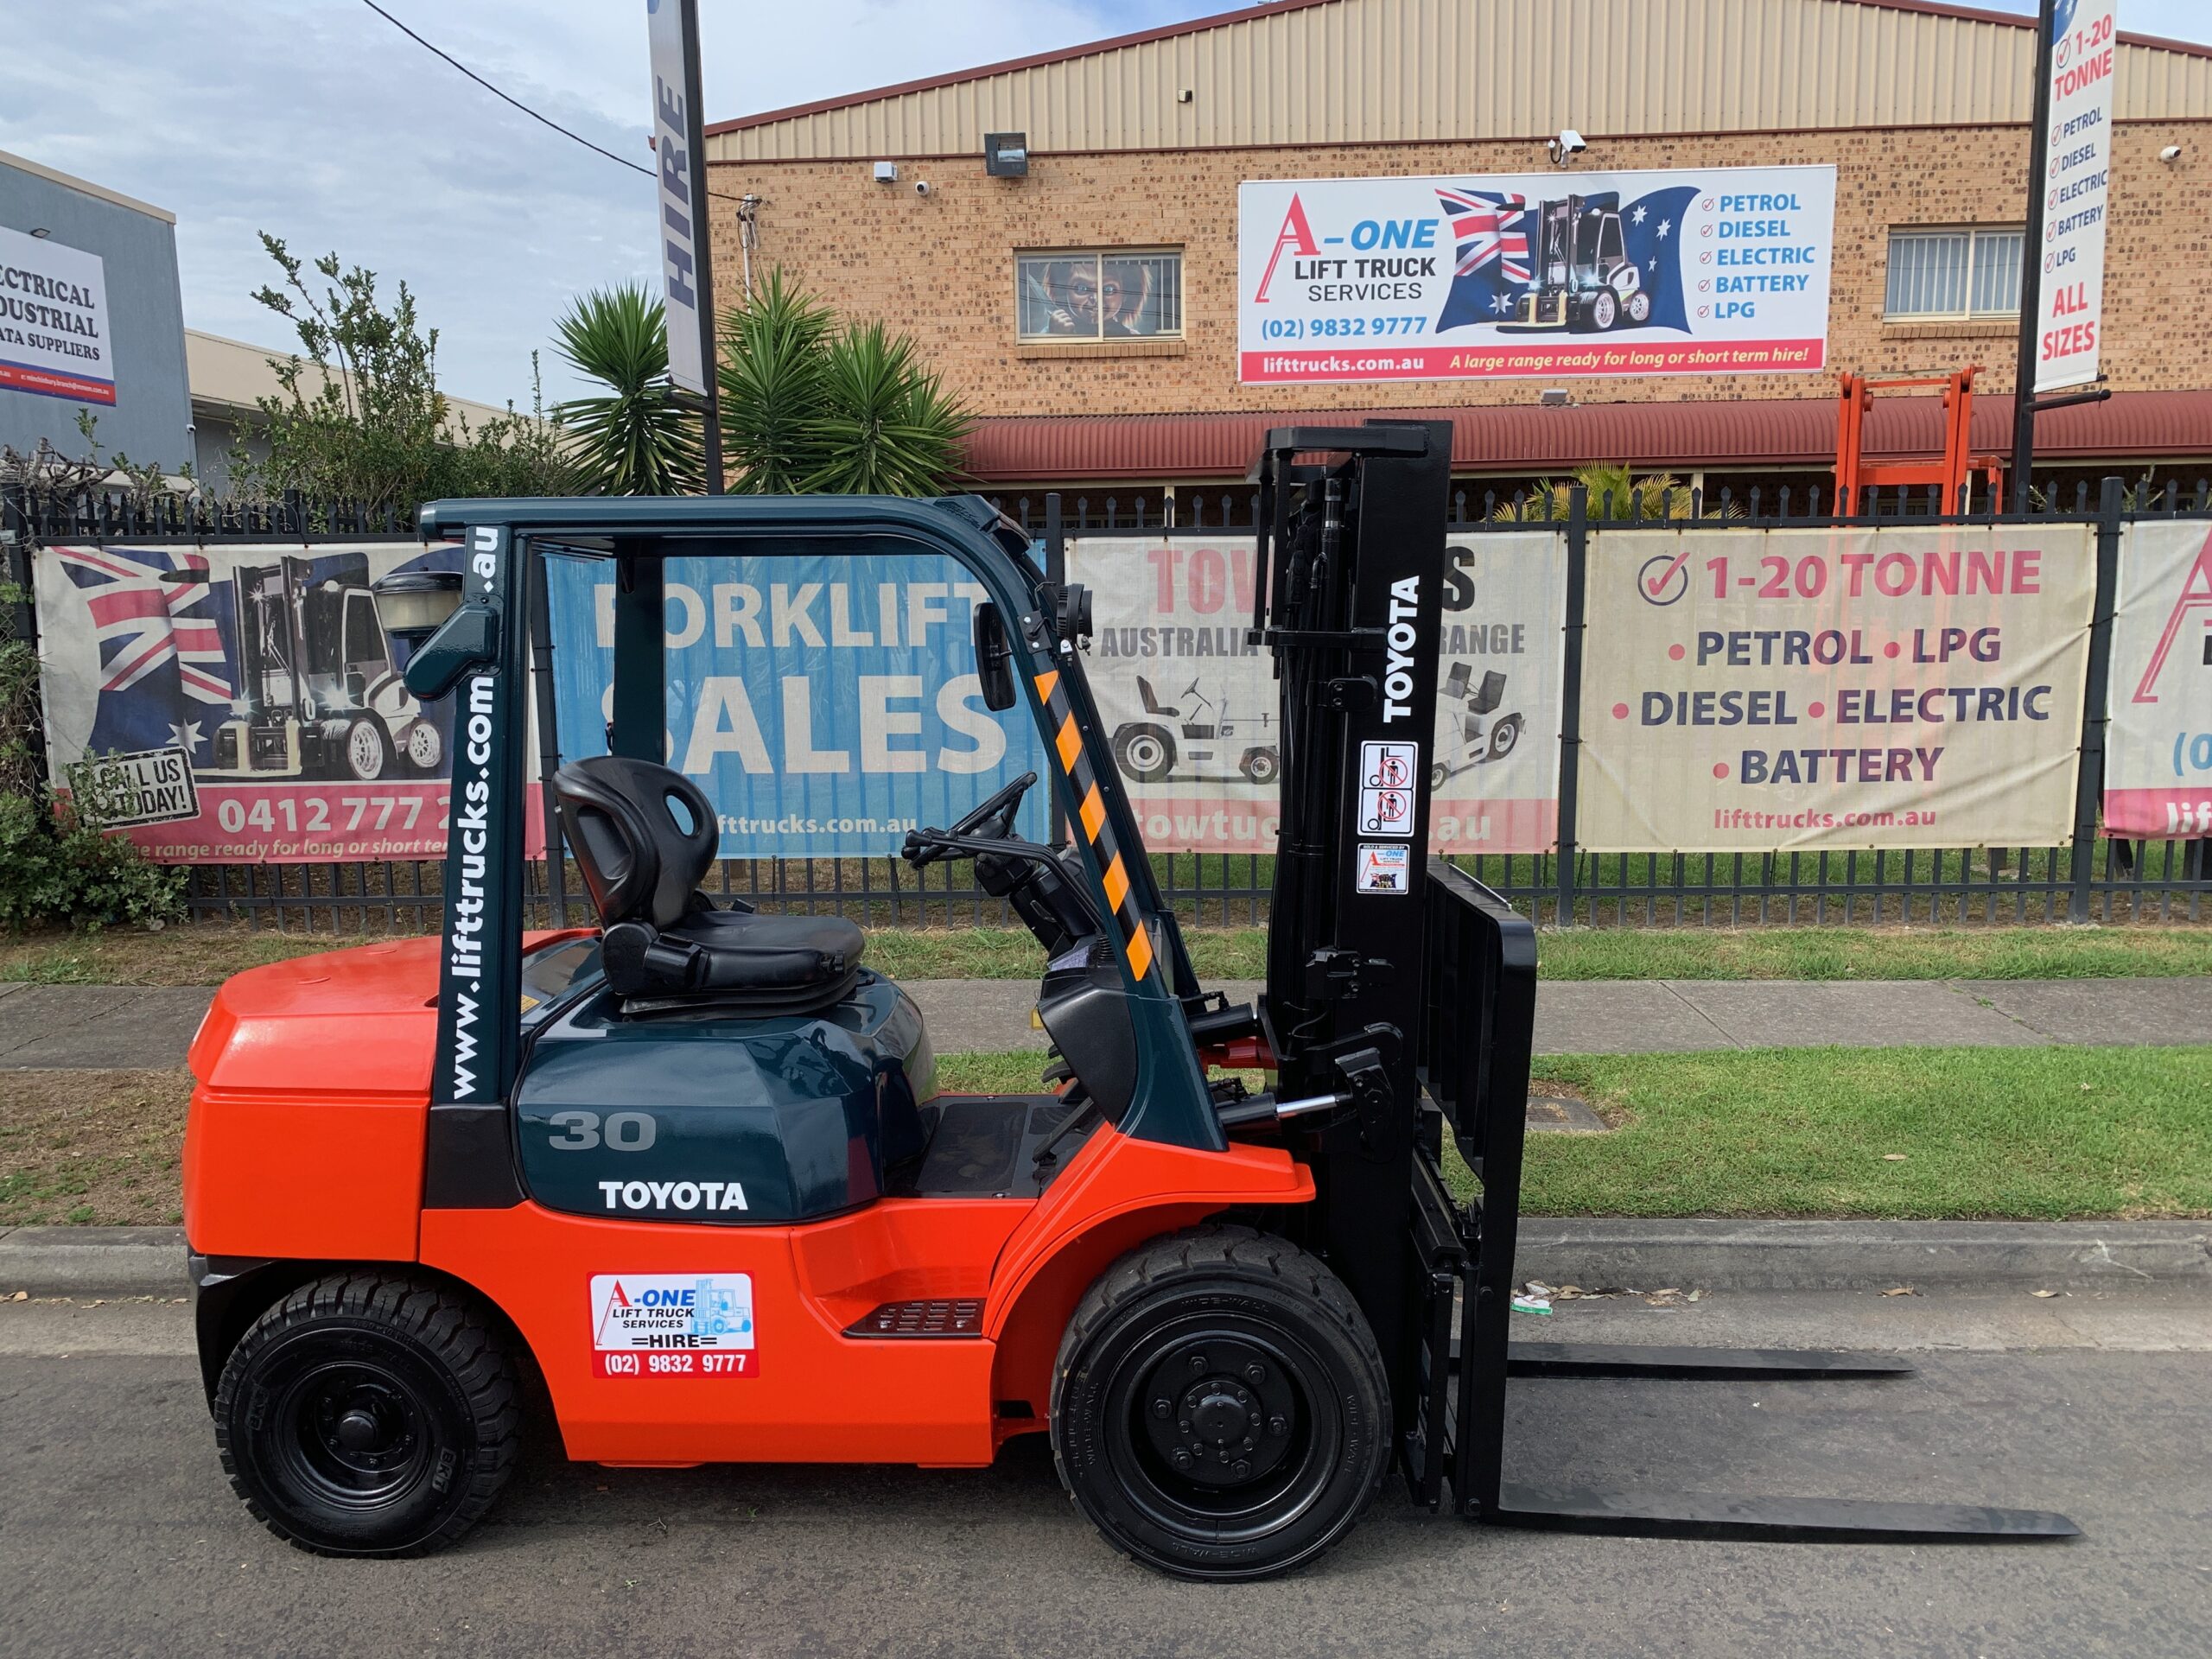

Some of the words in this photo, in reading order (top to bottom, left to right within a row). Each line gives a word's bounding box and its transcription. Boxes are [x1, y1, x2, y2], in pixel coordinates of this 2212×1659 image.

[2075, 14, 2112, 54] 1-20
[2055, 48, 2113, 101] TONNE
[2063, 106, 2103, 139] PETROL
[2062, 143, 2096, 173] DIESEL
[657, 74, 695, 310] HIRE
[2059, 169, 2108, 204] ELECTRIC
[1719, 194, 1801, 213] PETROL
[1719, 220, 1790, 238] DIESEL
[2057, 205, 2104, 236] BATTERY
[1295, 260, 1348, 280] LIFT
[1355, 257, 1436, 278] TRUCK
[1717, 246, 1816, 266] ELECTRIC
[2056, 247, 2075, 269] LPG
[1308, 283, 1422, 302] SERVICES
[1716, 275, 1809, 293] BATTERY
[1714, 302, 1755, 319] LPG
[2052, 281, 2088, 319] ALL
[1262, 319, 1305, 340] (02)
[1310, 318, 1366, 337] 9832
[1371, 316, 1427, 335] 9777
[2042, 321, 2095, 361] SIZES
[28, 333, 100, 360] SUPPLIERS
[1450, 355, 1460, 368] A
[1465, 354, 1504, 371] large
[1508, 356, 1553, 370] range
[1556, 352, 1601, 369] ready
[1604, 351, 1627, 365] for
[1630, 351, 1664, 368] long
[1668, 353, 1686, 364] or
[1687, 349, 1729, 364] short
[1732, 349, 1769, 363] term
[1772, 347, 1809, 362] hire!
[1263, 356, 1424, 373] lifttrucks.com.au
[1707, 554, 1827, 599] 1-20
[1841, 550, 2041, 597] TONNE
[1383, 575, 1420, 722] TOYOTA
[1697, 630, 1872, 665] PETROL
[1913, 627, 2001, 663] LPG
[1642, 690, 1797, 726] DIESEL
[1837, 685, 2052, 724] ELECTRIC
[153, 759, 181, 784] US
[1741, 747, 1945, 785] BATTERY
[218, 798, 332, 833] 0412
[342, 797, 423, 830] 777
[1715, 808, 1936, 830] lifttrucks.com.au
[156, 843, 210, 861] range
[215, 840, 269, 860] ready
[272, 839, 300, 855] for
[303, 839, 344, 857] long
[348, 840, 368, 853] or
[372, 837, 422, 854] short
[549, 1111, 657, 1151] 30
[599, 1181, 748, 1210] TOYOTA
[613, 1308, 642, 1318] LIFT
[647, 1308, 695, 1318] TRUCK
[622, 1319, 683, 1328] SERVICES
[605, 1353, 639, 1375] (02)
[649, 1354, 693, 1373] 9832
[702, 1354, 747, 1372] 9777
